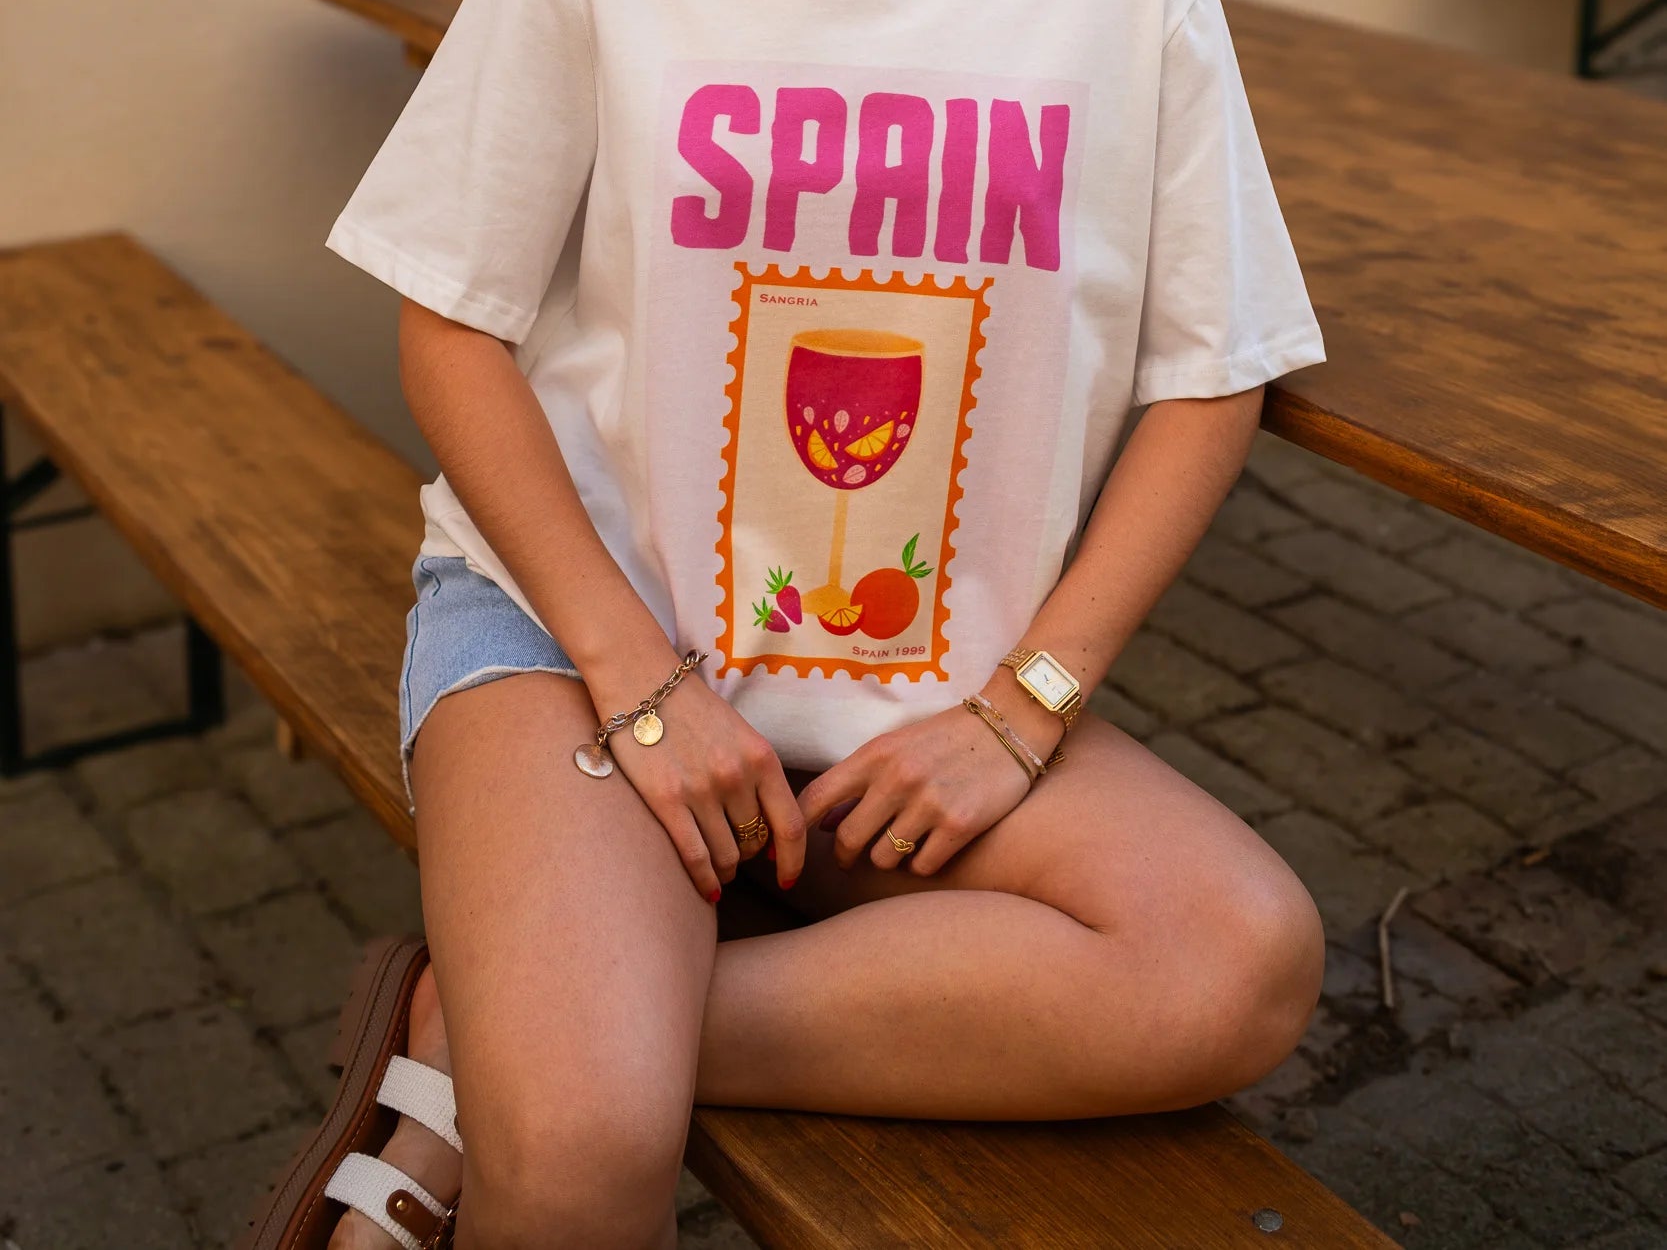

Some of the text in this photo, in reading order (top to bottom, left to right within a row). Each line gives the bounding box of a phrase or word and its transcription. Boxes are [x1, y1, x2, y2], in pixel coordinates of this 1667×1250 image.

[671, 84, 1070, 272] SPAIN
[759, 293, 818, 307] SANGRIA
[852, 645, 926, 658] SPAIN 1999
